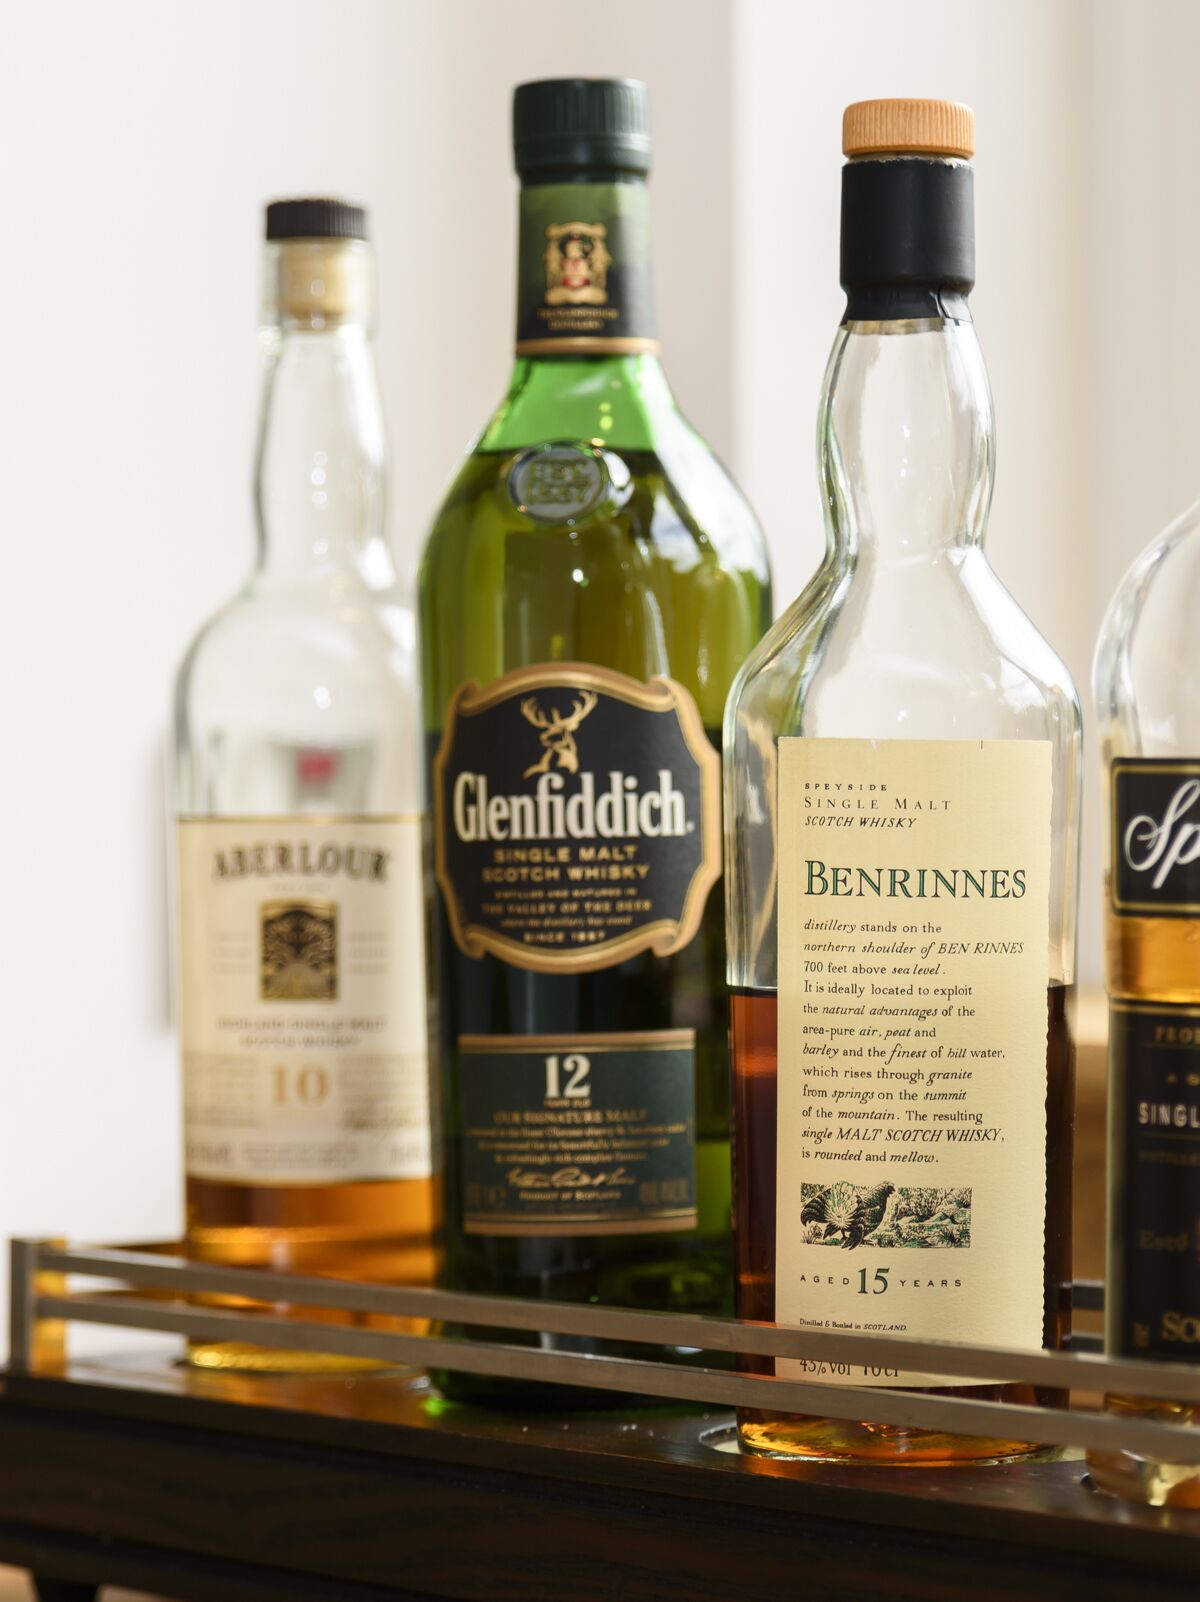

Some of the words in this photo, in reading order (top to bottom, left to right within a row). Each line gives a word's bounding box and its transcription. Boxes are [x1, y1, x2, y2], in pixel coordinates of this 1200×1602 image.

[804, 782, 888, 792] SPEYSIDE
[805, 815, 854, 828] SCOTCH
[859, 816, 917, 829] WHISKY
[214, 841, 389, 882] ABERLOUR
[494, 848, 571, 862] SINGLE
[579, 845, 637, 861] MALT
[482, 868, 560, 882] SCOTCH
[567, 865, 649, 881] WHISKY
[804, 860, 1026, 899] BENRINNES
[803, 919, 857, 933] distillery
[860, 922, 897, 934] stands
[902, 924, 918, 934] on
[922, 922, 942, 934] the
[803, 942, 856, 953] northern
[862, 942, 917, 954] shoulder
[920, 941, 936, 959] of
[937, 942, 970, 954] BEN
[973, 942, 1025, 954] RINNES
[803, 961, 824, 973] 700
[828, 962, 848, 974] feet
[852, 963, 887, 975] above
[891, 966, 910, 975] sea
[804, 980, 813, 994] It
[816, 982, 825, 993] is
[828, 982, 865, 998] ideally
[871, 984, 914, 996] located
[918, 985, 930, 996] to
[933, 985, 972, 1001] exploit
[803, 1003, 819, 1014] the
[822, 1005, 865, 1016] natural
[869, 1005, 939, 1021] advantages
[941, 1005, 954, 1017] of
[957, 1006, 976, 1017] the
[802, 1024, 856, 1040] area-pure
[883, 1028, 912, 1041] peat
[914, 1027, 936, 1038] and
[802, 1043, 840, 1059] barley
[842, 1047, 863, 1058] and
[867, 1047, 887, 1058] the
[884, 1043, 927, 1065] finest
[930, 1047, 944, 1058] of
[947, 1047, 967, 1059] hill
[271, 1064, 328, 1105] 10
[545, 1054, 591, 1098] 12
[802, 1066, 839, 1078] which
[843, 1068, 872, 1079] rises
[876, 1068, 925, 1085] through
[926, 1069, 973, 1087] granite
[802, 1085, 828, 1099] from
[831, 1087, 875, 1104] springs
[877, 1091, 894, 1101] on
[899, 1089, 919, 1101] the
[923, 1089, 967, 1101] summit
[801, 1107, 813, 1119] of
[816, 1107, 833, 1119] the
[837, 1108, 900, 1121] mountain.
[905, 1110, 928, 1122] The
[932, 1110, 983, 1125] resulting
[801, 1127, 833, 1144] single
[836, 1127, 883, 1141] MALT
[885, 1128, 943, 1142] SCOTCH
[801, 1147, 811, 1159] is
[814, 1149, 862, 1161] rounded
[865, 1151, 887, 1162] and
[889, 1152, 939, 1164] mellow.
[799, 1274, 850, 1285] AGED
[857, 1266, 890, 1295] 15
[899, 1279, 962, 1288] YEARS
